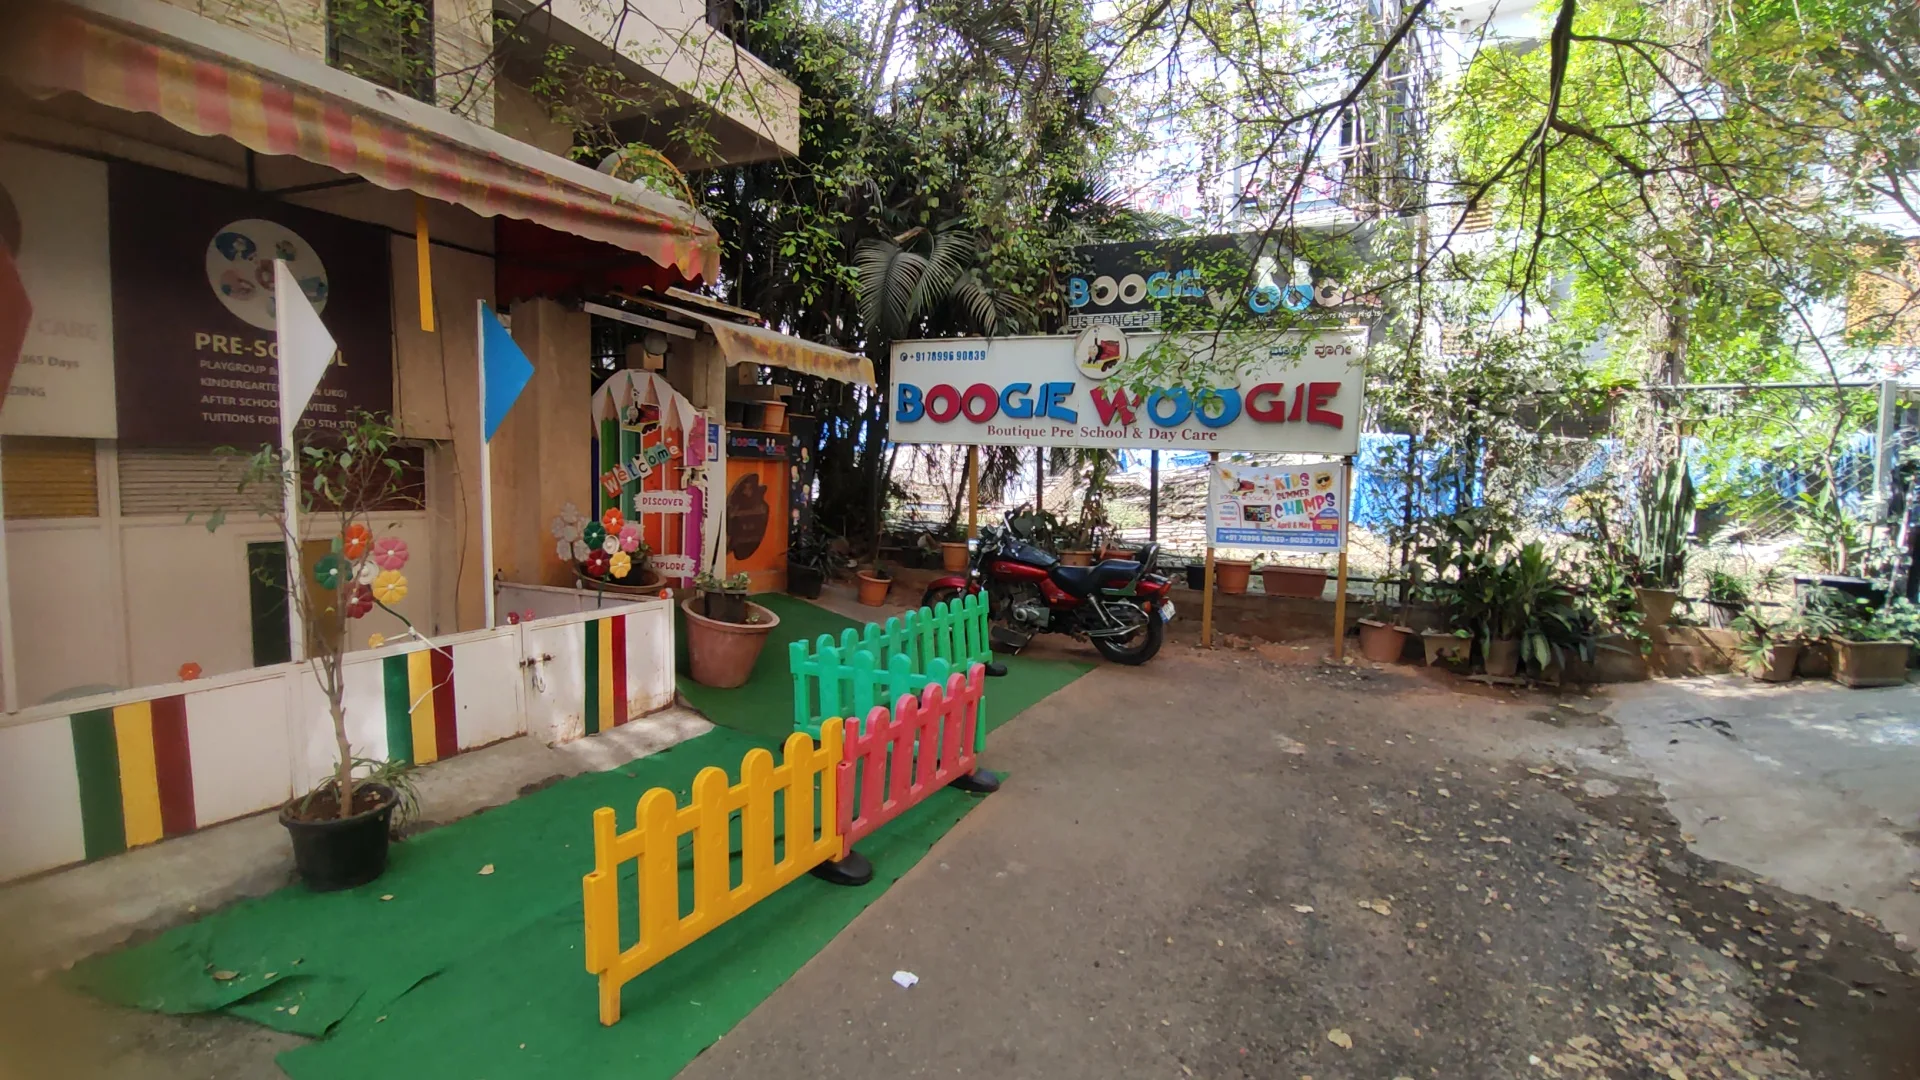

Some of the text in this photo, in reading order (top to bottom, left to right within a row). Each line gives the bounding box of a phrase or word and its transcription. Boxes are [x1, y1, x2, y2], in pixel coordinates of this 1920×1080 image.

[1068, 269, 1205, 308] BOOGIE
[1070, 316, 1088, 329] US
[47, 356, 80, 370] Days
[956, 350, 987, 361] 90839
[200, 360, 267, 375] PLAYGROUP
[200, 377, 280, 392] KINDERGARTE
[200, 394, 237, 406] AFTER
[239, 398, 281, 409] SCHOO
[895, 382, 1345, 431] BOOGIE WOOGIE
[202, 412, 256, 424] TUITIONS
[257, 415, 280, 425] FOR
[302, 418, 317, 429] TO
[987, 425, 1218, 442] Boutique Pre School & Day Care
[1273, 472, 1310, 491] KIDS
[642, 496, 684, 507] DISCOVER
[1276, 488, 1310, 500] SUMMER
[1274, 492, 1336, 519] CHAMPS
[650, 560, 687, 572] EXPLORE
